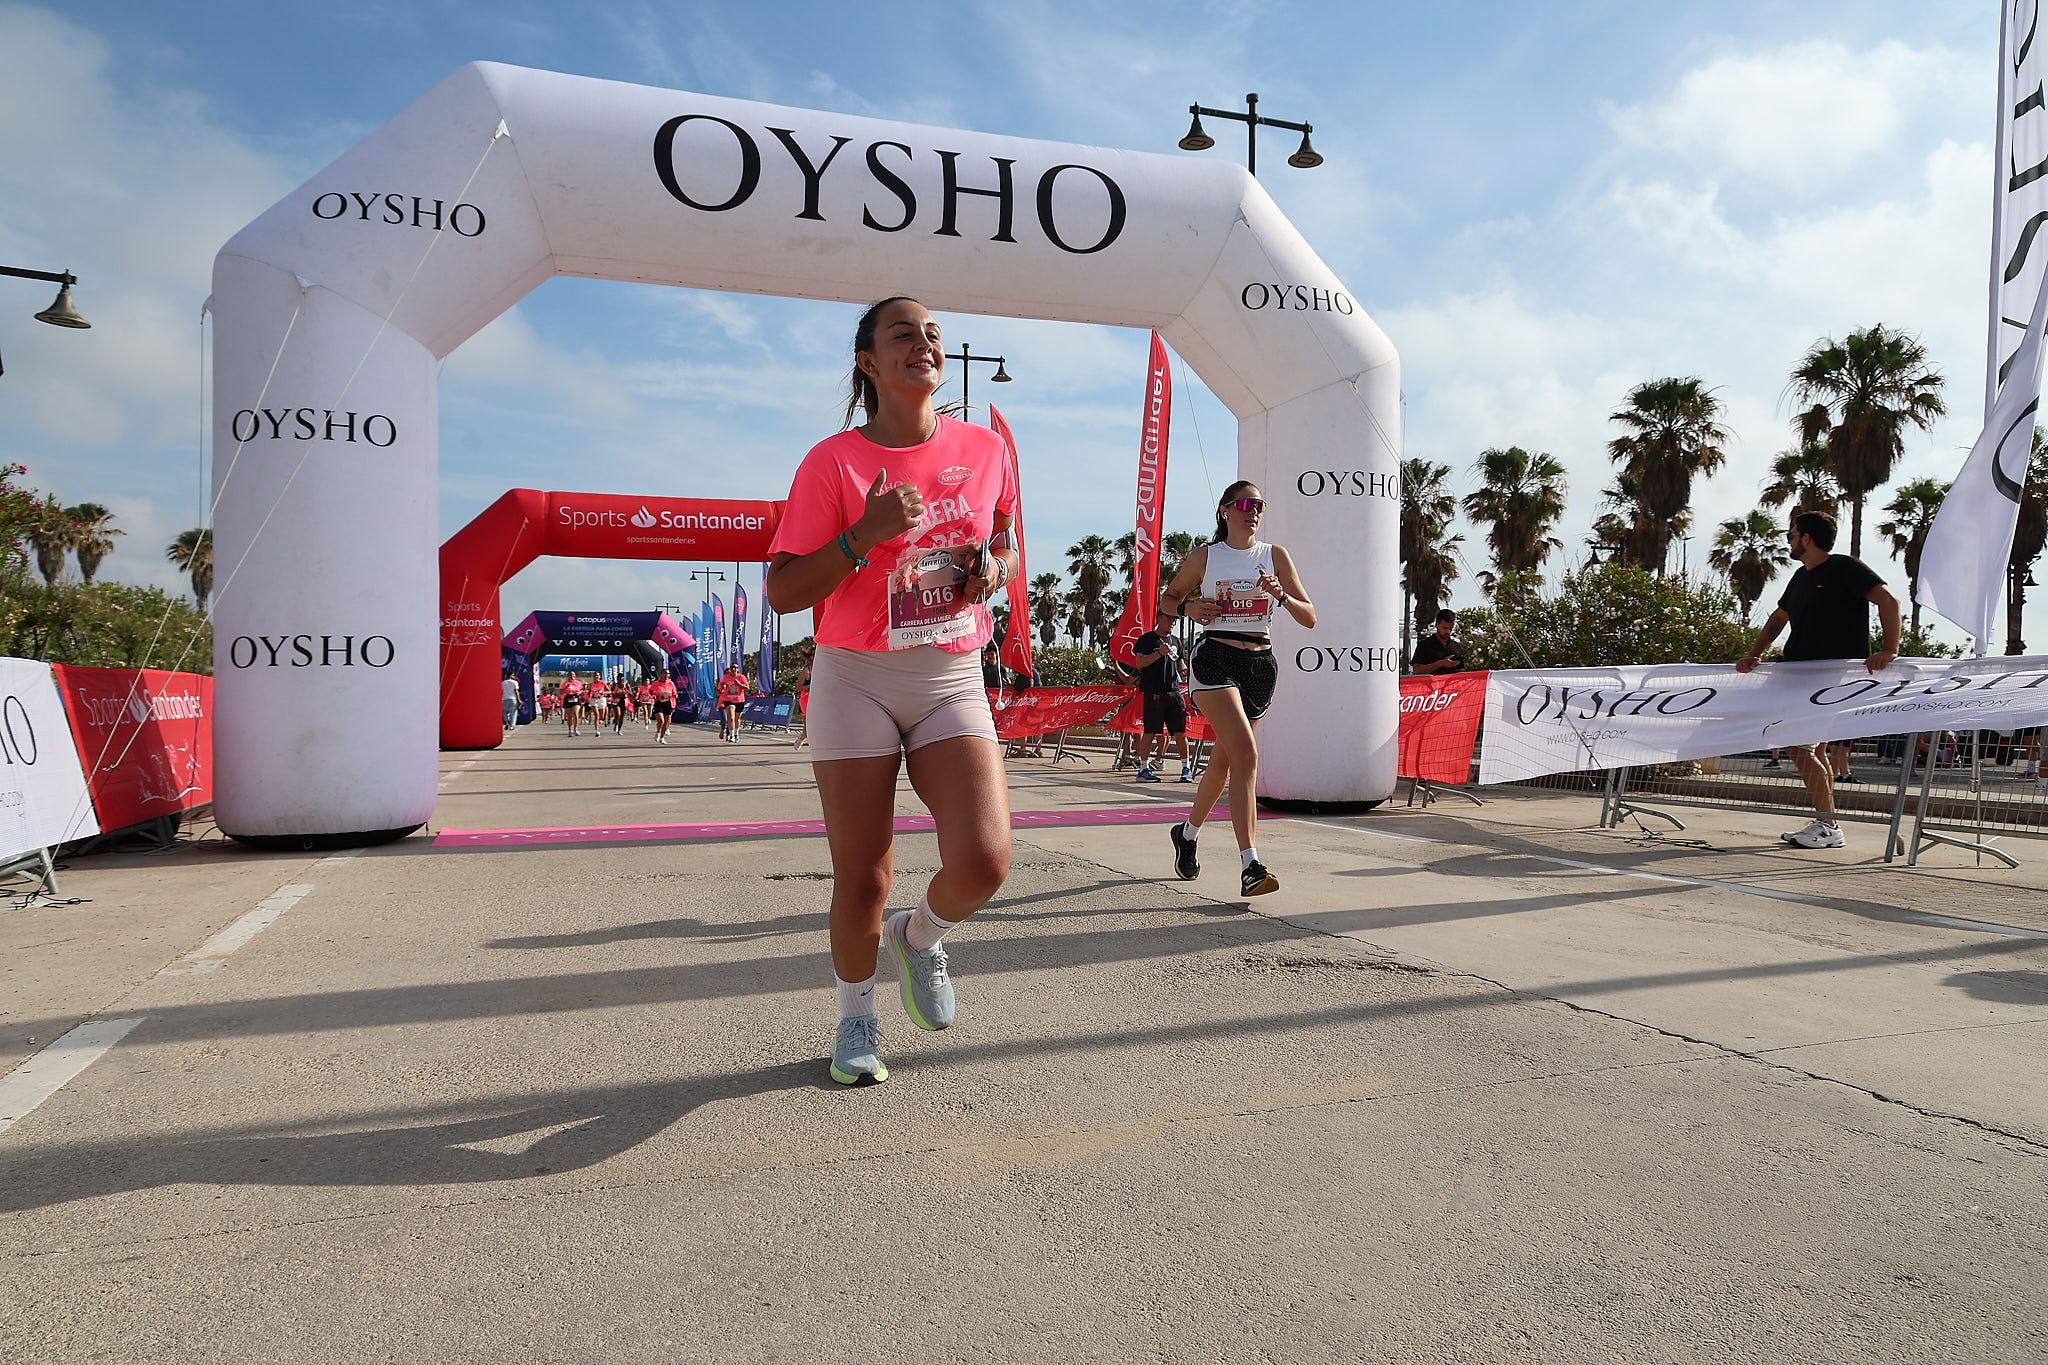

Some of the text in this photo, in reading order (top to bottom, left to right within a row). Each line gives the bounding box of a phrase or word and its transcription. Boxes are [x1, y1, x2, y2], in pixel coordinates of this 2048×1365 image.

[653, 114, 1127, 254] OYSHO
[312, 192, 486, 237] OYSHO
[1241, 282, 1353, 316] OYSHO
[232, 407, 397, 447] OYSHO
[1297, 470, 1399, 500] OYSHO
[559, 506, 765, 531] Sports Santander
[626, 536, 696, 545] sportssantander.es
[922, 586, 953, 606] 016
[1232, 599, 1253, 608] 016
[445, 602, 494, 627] Sports Santander
[577, 616, 606, 624] octopus
[552, 639, 623, 647] VOLVO
[902, 629, 932, 640] OYSHO
[230, 634, 395, 670] OYSHO
[1295, 646, 1398, 673] OYSHO
[79, 687, 132, 735] Sports
[143, 688, 203, 721] Santander
[1398, 689, 1458, 712] ander
[1517, 684, 1717, 725] OYSHO
[1855, 699, 2014, 716] WWW.OYSHO.COM
